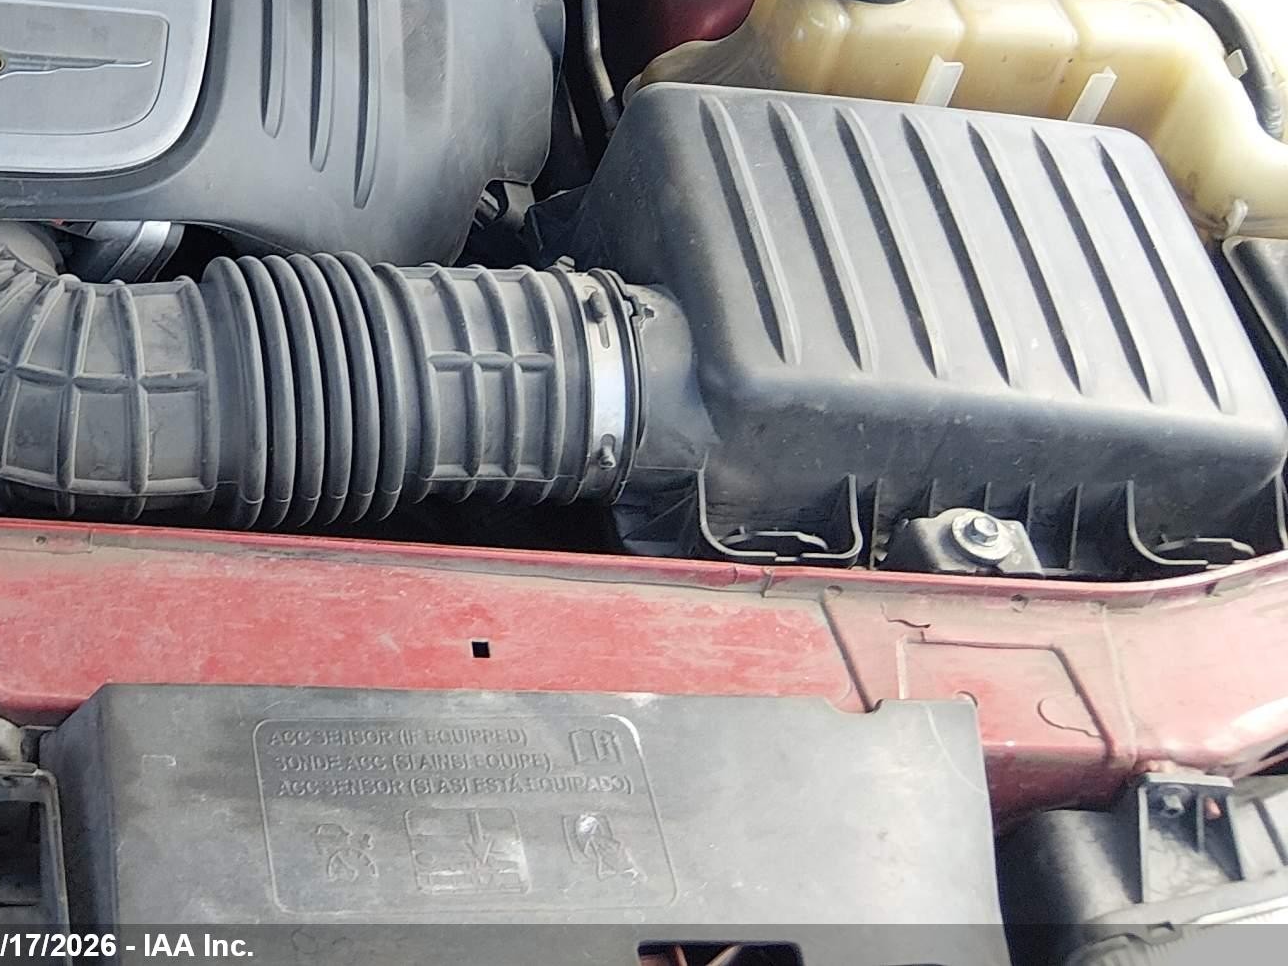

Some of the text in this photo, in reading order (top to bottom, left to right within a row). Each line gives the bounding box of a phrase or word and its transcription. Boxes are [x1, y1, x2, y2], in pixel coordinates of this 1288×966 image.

[269, 729, 312, 747] ACC
[346, 753, 388, 771] ACC
[278, 778, 320, 796] ACC
